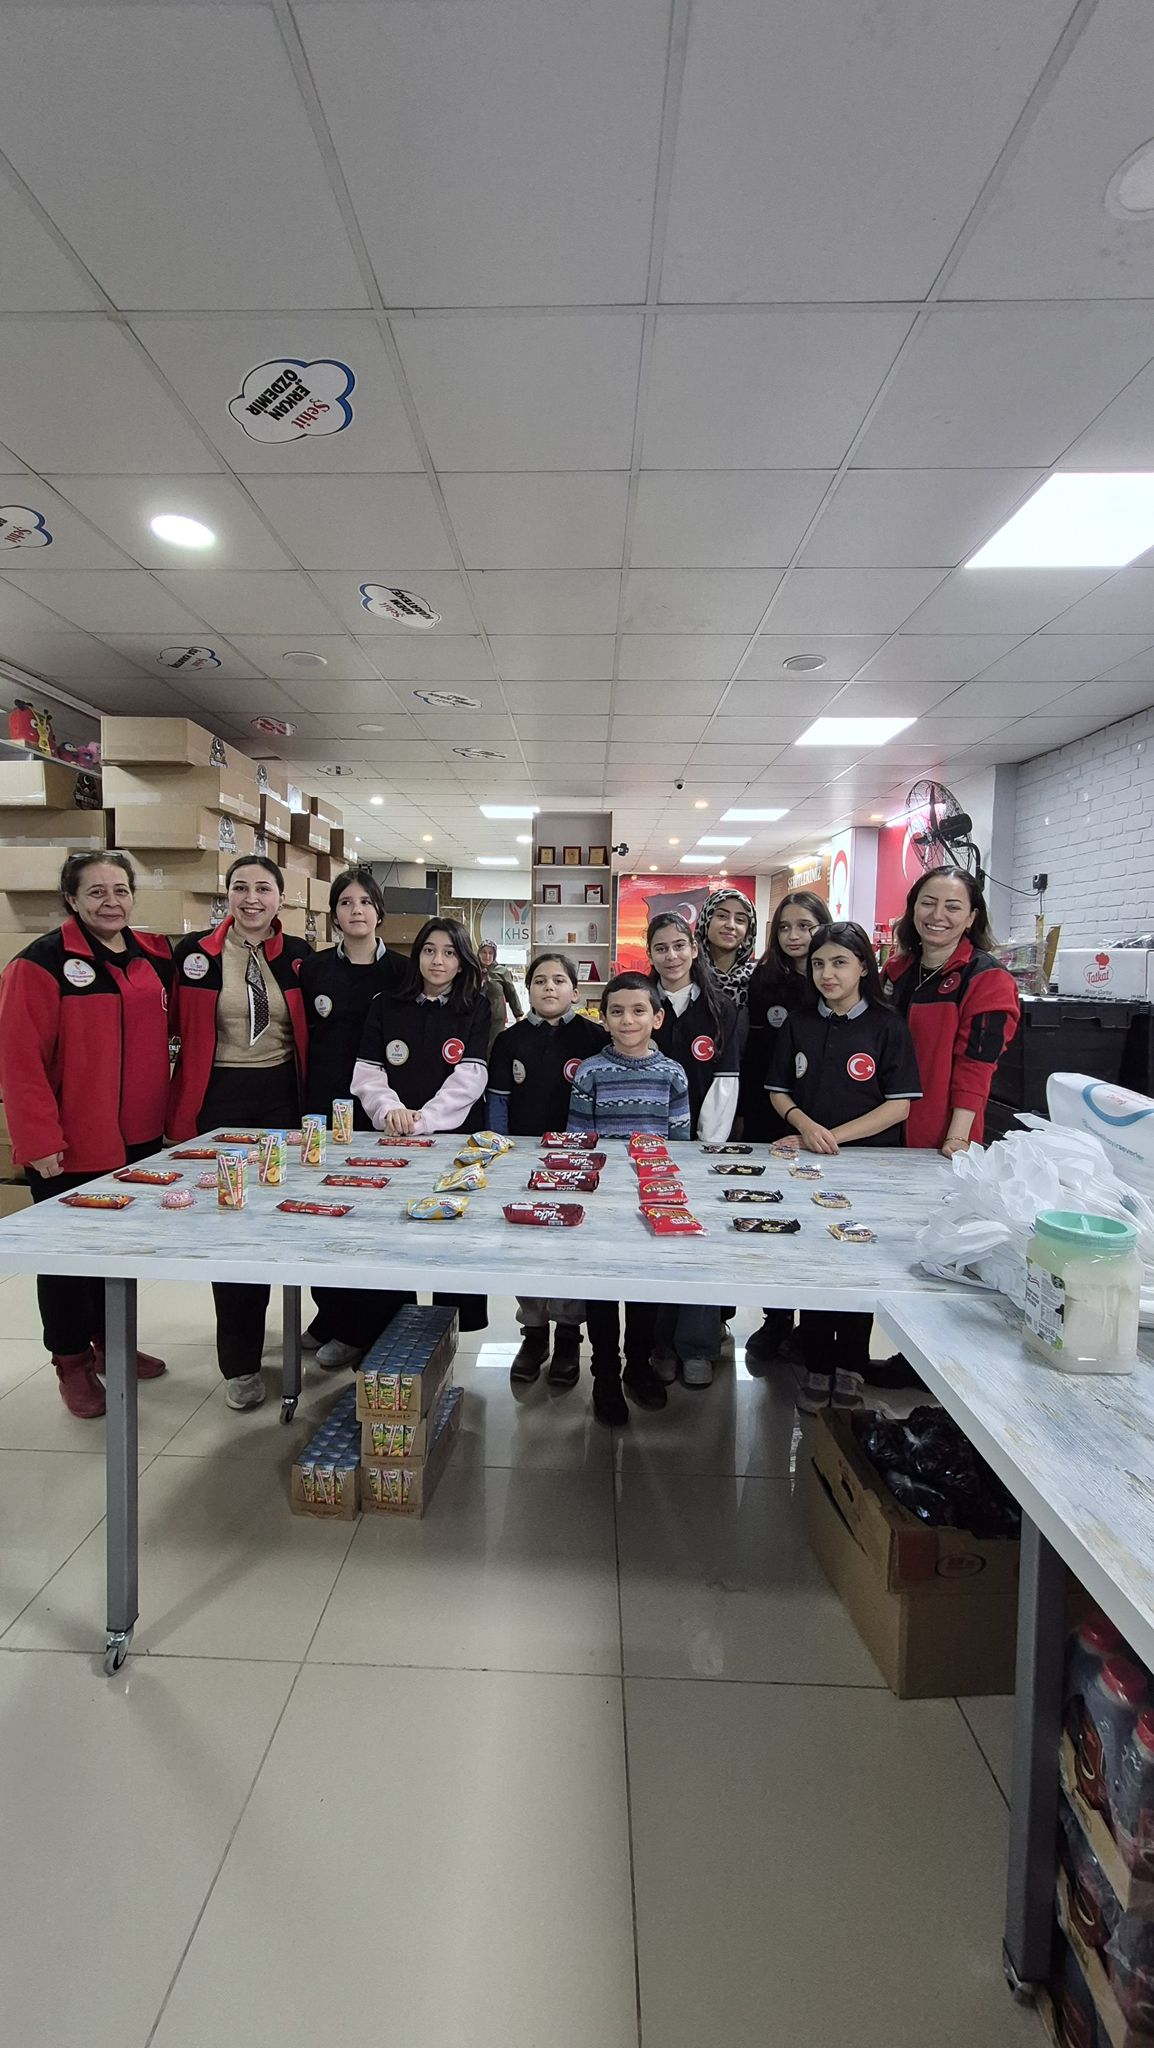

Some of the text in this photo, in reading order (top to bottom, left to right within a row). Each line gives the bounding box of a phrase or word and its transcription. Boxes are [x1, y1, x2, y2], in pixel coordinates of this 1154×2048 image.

[245, 369, 302, 416] ÖZDEMİR
[268, 384, 311, 421] ERKAN
[290, 398, 330, 429] Şehit
